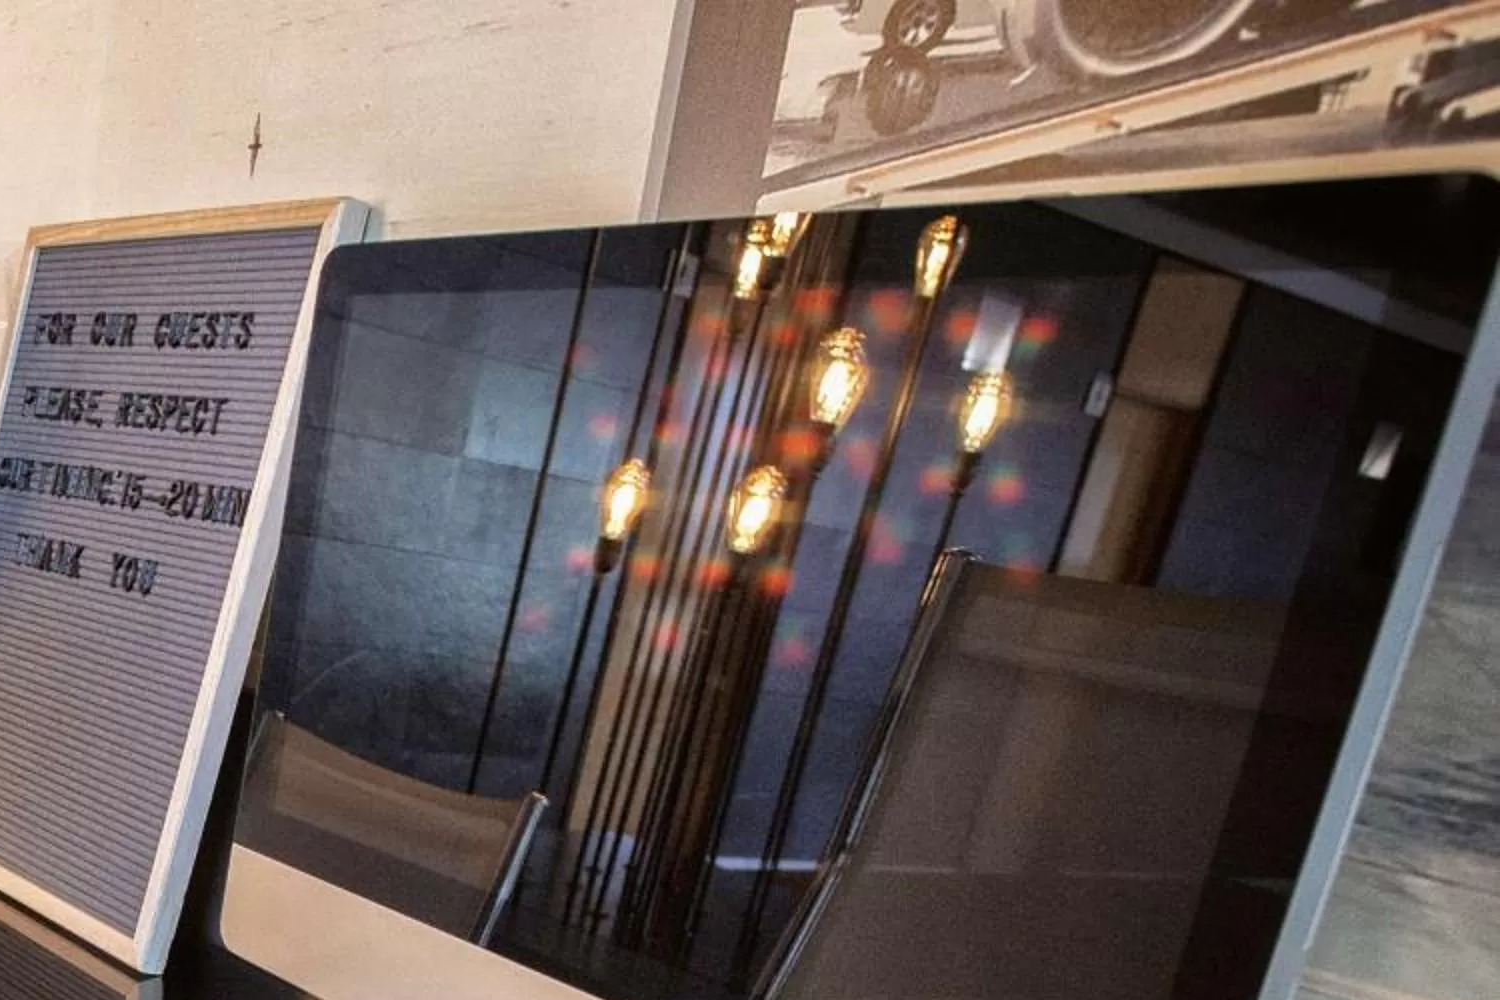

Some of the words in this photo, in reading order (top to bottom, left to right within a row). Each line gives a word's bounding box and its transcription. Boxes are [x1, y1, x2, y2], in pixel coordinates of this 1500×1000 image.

[34, 313, 77, 345] FOR
[90, 312, 137, 347] OUR
[154, 311, 255, 350] GUESTS
[22, 386, 104, 428] PLEASE
[115, 391, 230, 435] RESPECT
[17, 532, 85, 578] THANK
[110, 552, 159, 597] YOU
